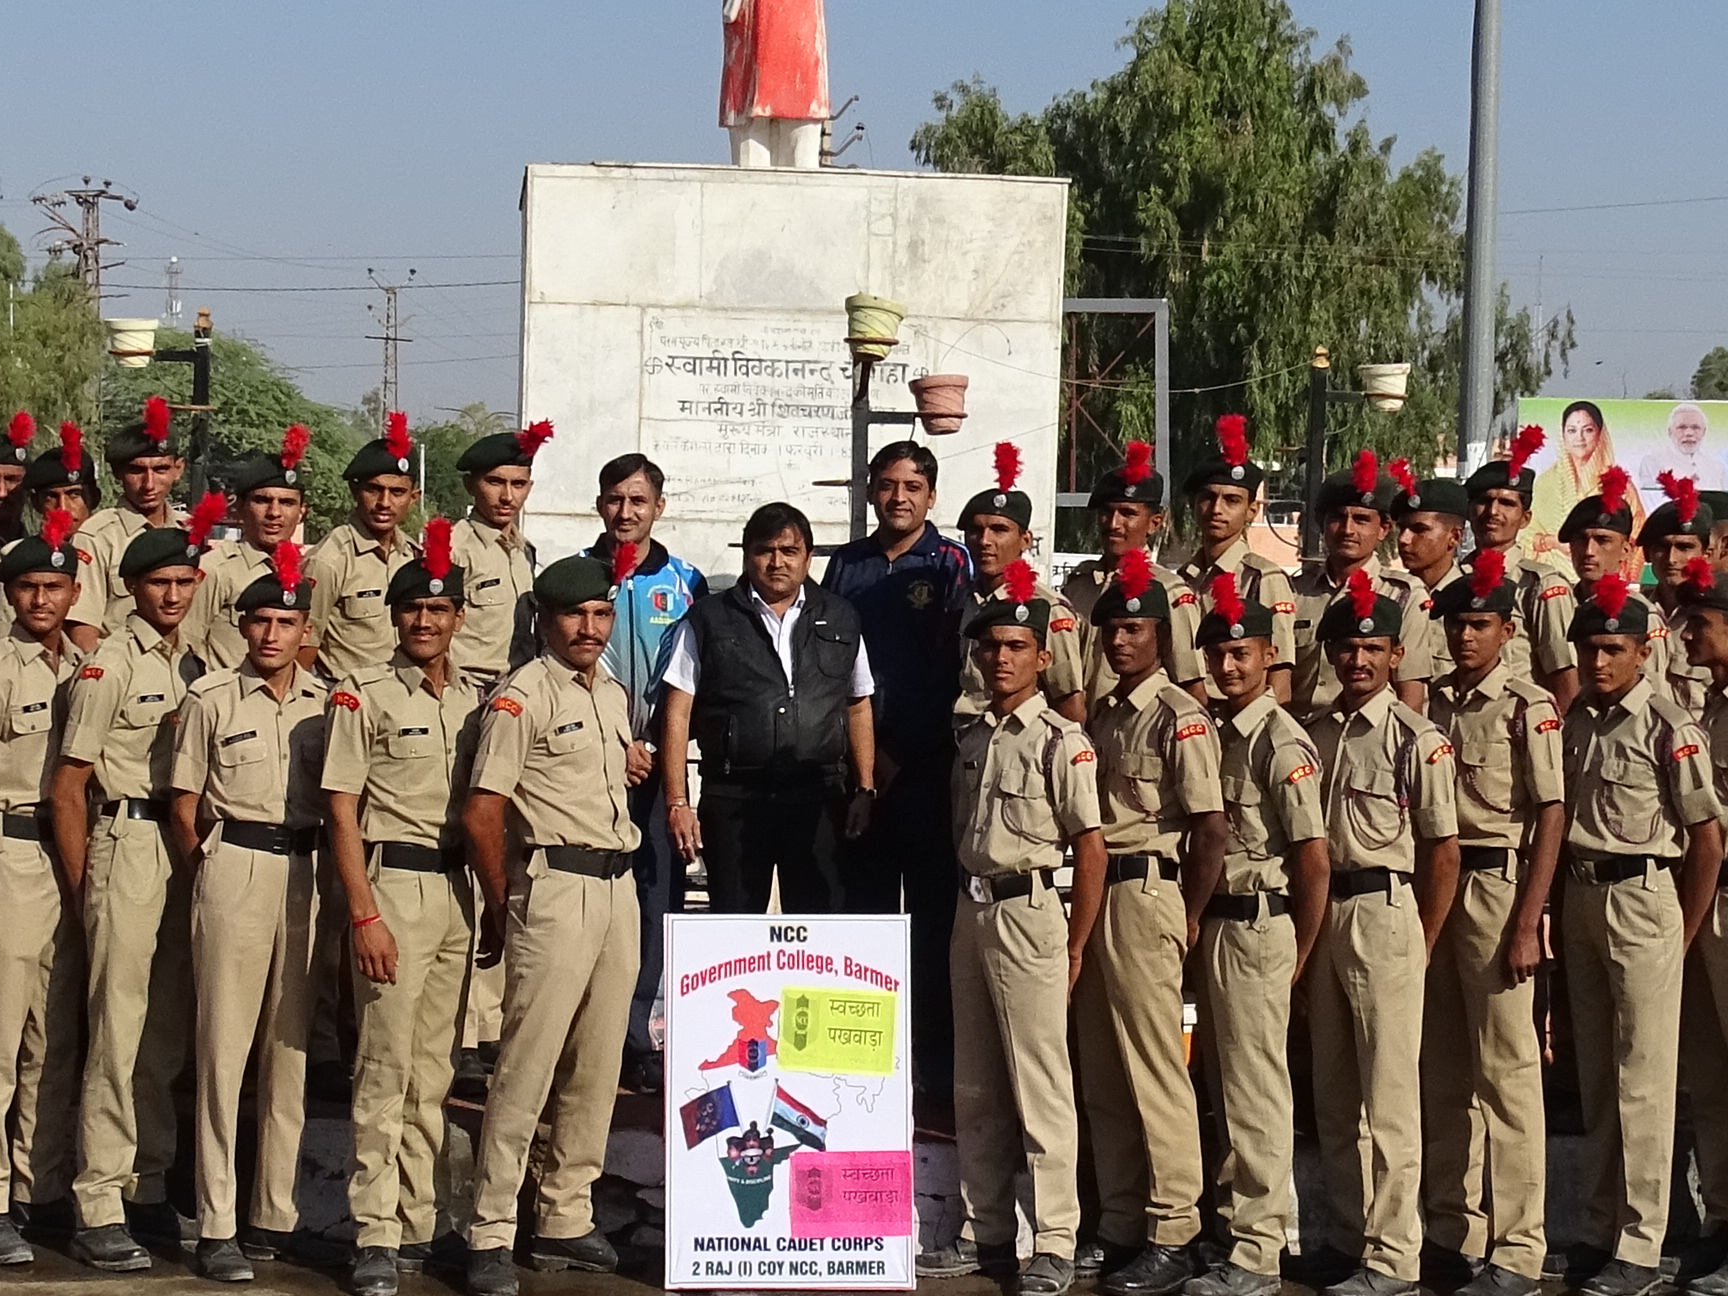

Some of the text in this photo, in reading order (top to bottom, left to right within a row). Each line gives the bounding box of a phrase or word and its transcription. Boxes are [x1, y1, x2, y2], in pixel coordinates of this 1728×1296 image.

[664, 349, 730, 377] स्वामी
[731, 350, 835, 385] विवेकानन्द
[747, 398, 769, 418] श्री
[769, 926, 808, 943] NCC
[680, 949, 900, 997] Government College, Barmer
[828, 999, 881, 1018] स्वच्छता
[827, 1027, 883, 1051] पखवाड़ा
[841, 1167, 894, 1181] स्वच्छता
[693, 1237, 884, 1252] NATIONAL CADET CORPS
[692, 1261, 700, 1276] 2
[705, 1261, 733, 1276] RAJ
[758, 1261, 785, 1276] COY
[789, 1261, 823, 1277] NCC,
[827, 1261, 885, 1276] BARMER
